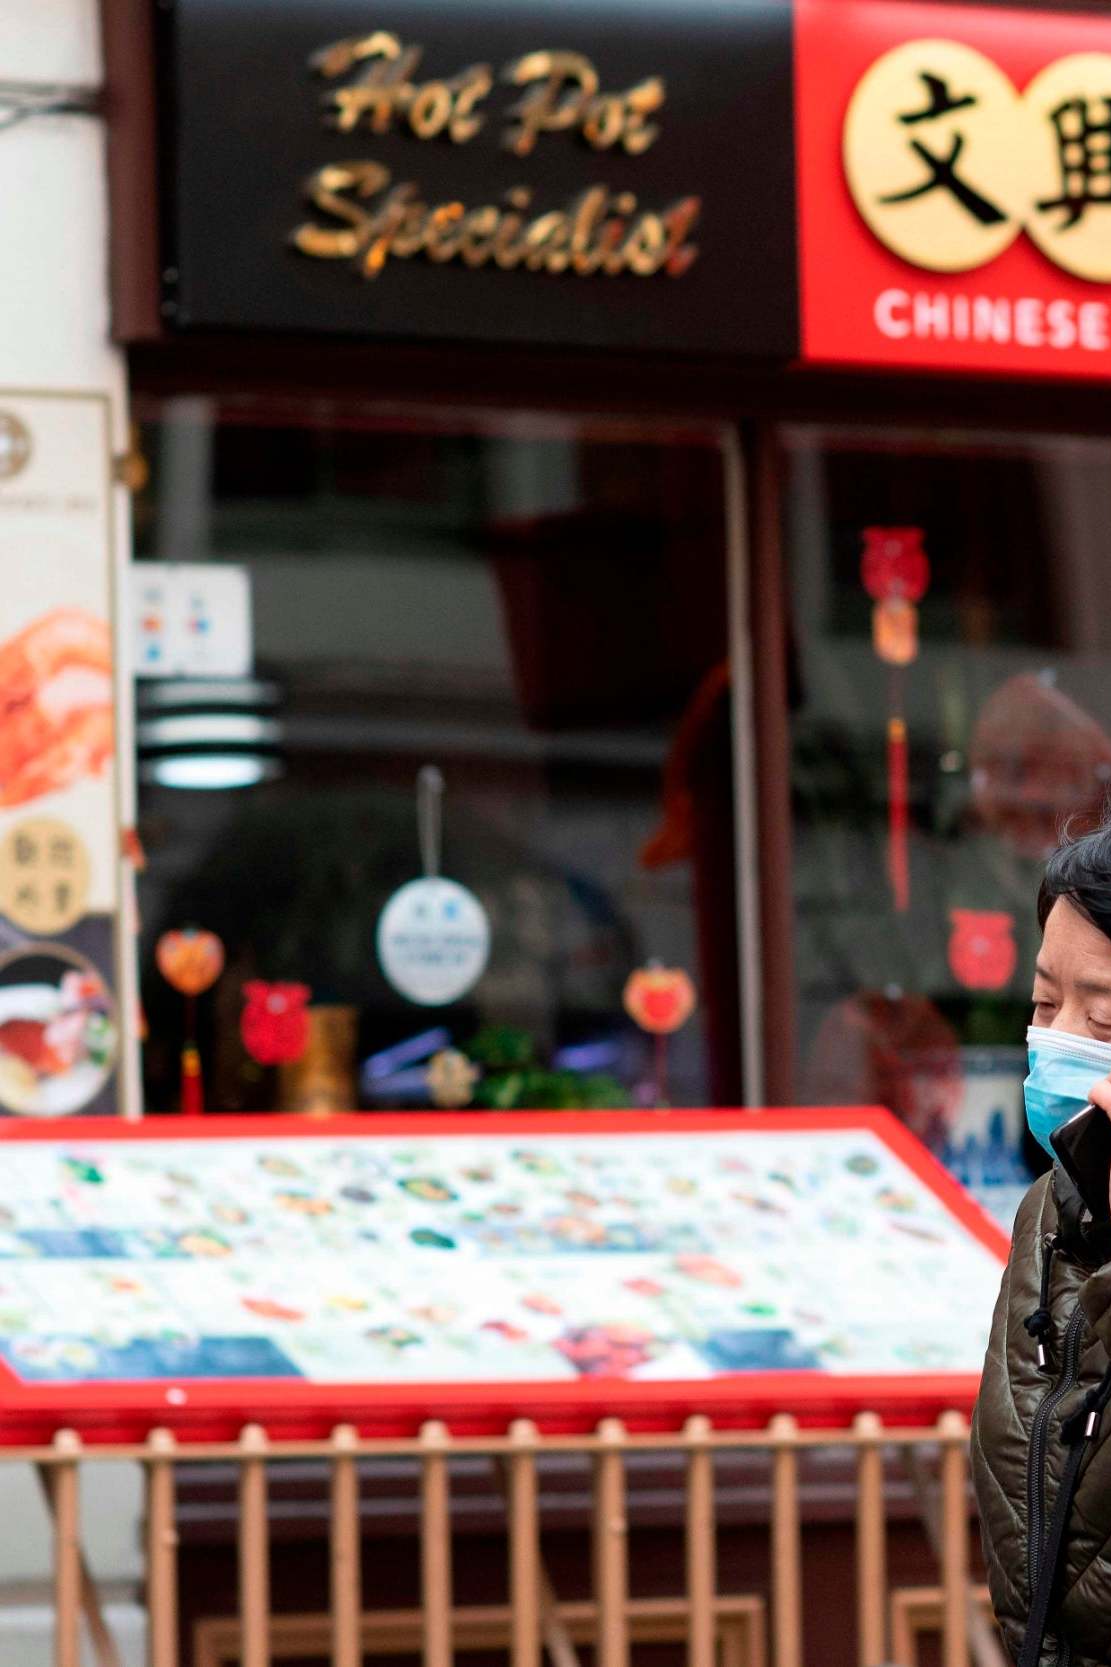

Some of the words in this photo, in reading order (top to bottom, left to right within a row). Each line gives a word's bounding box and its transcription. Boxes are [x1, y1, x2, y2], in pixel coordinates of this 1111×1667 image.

[306, 30, 494, 143] Hot
[507, 49, 666, 155] Pot
[290, 160, 701, 278] Specialist
[873, 289, 1109, 351] CHINESE
